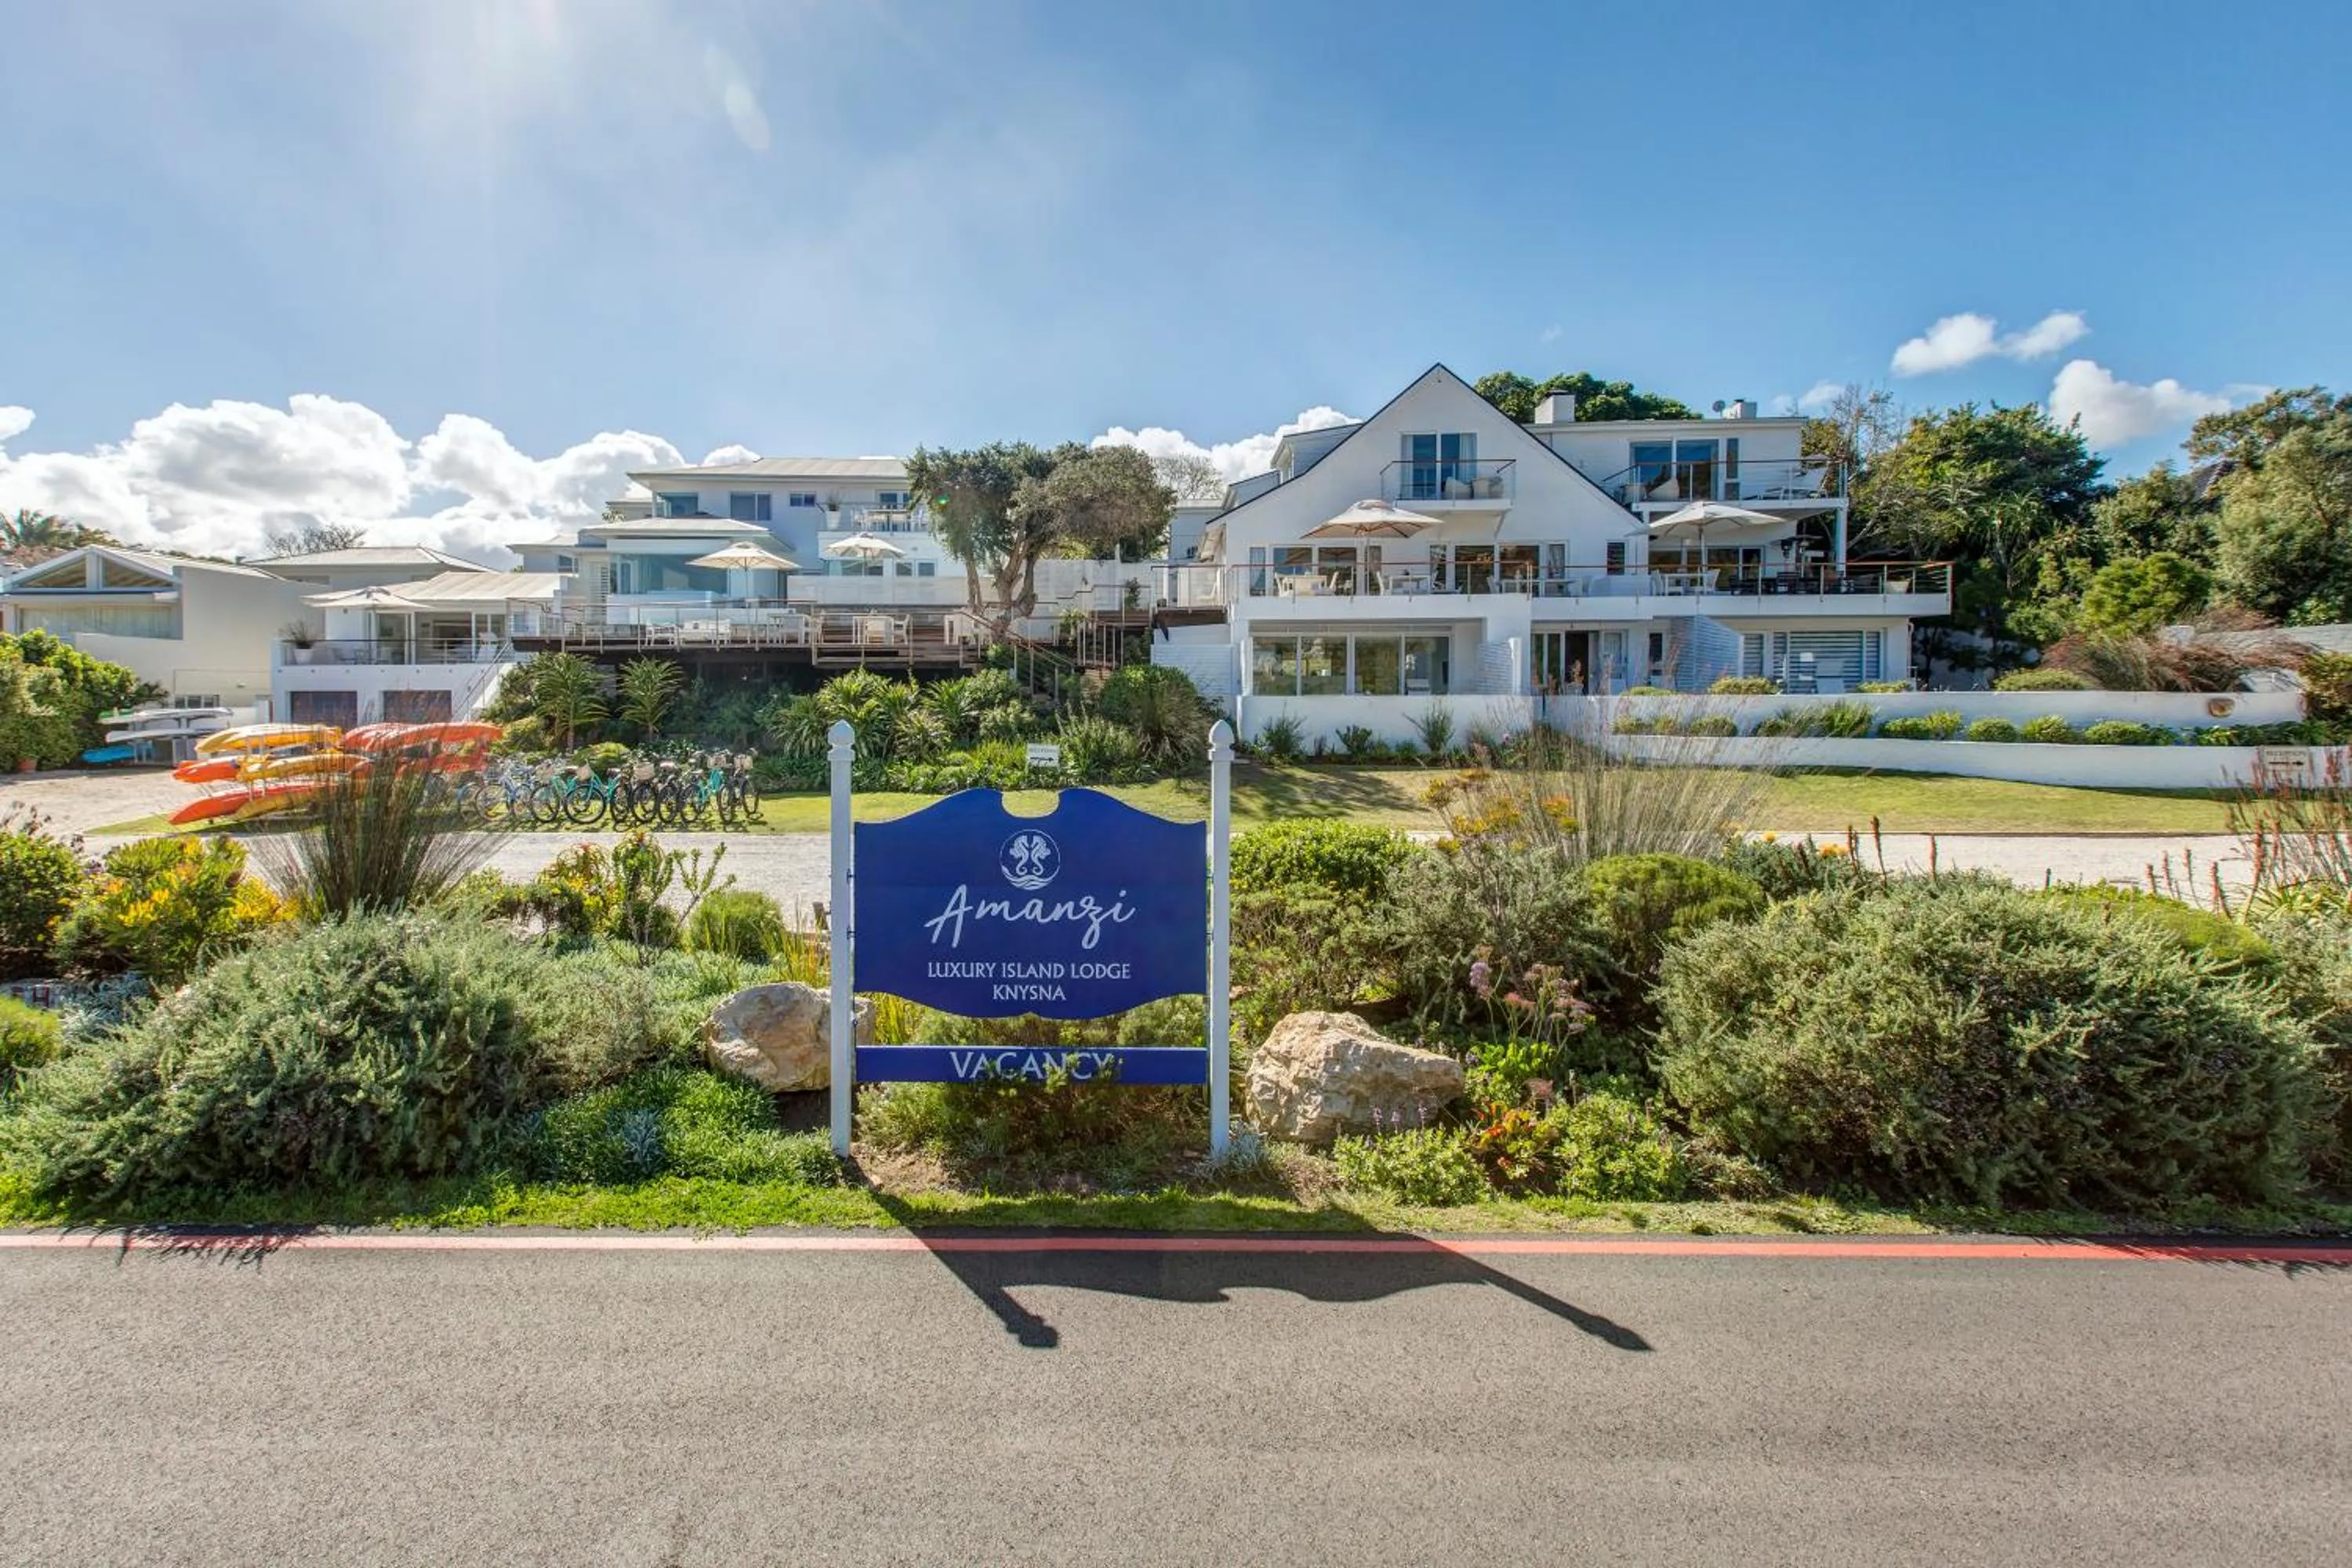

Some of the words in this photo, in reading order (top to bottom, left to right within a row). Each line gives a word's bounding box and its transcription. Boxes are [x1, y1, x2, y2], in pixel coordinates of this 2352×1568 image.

[924, 884, 1136, 949] Amanzi
[927, 963, 996, 978] LUXURY
[1001, 963, 1065, 979] ISLAND
[1071, 964, 1131, 979] LODGE
[993, 985, 1067, 1001] KNYSNA
